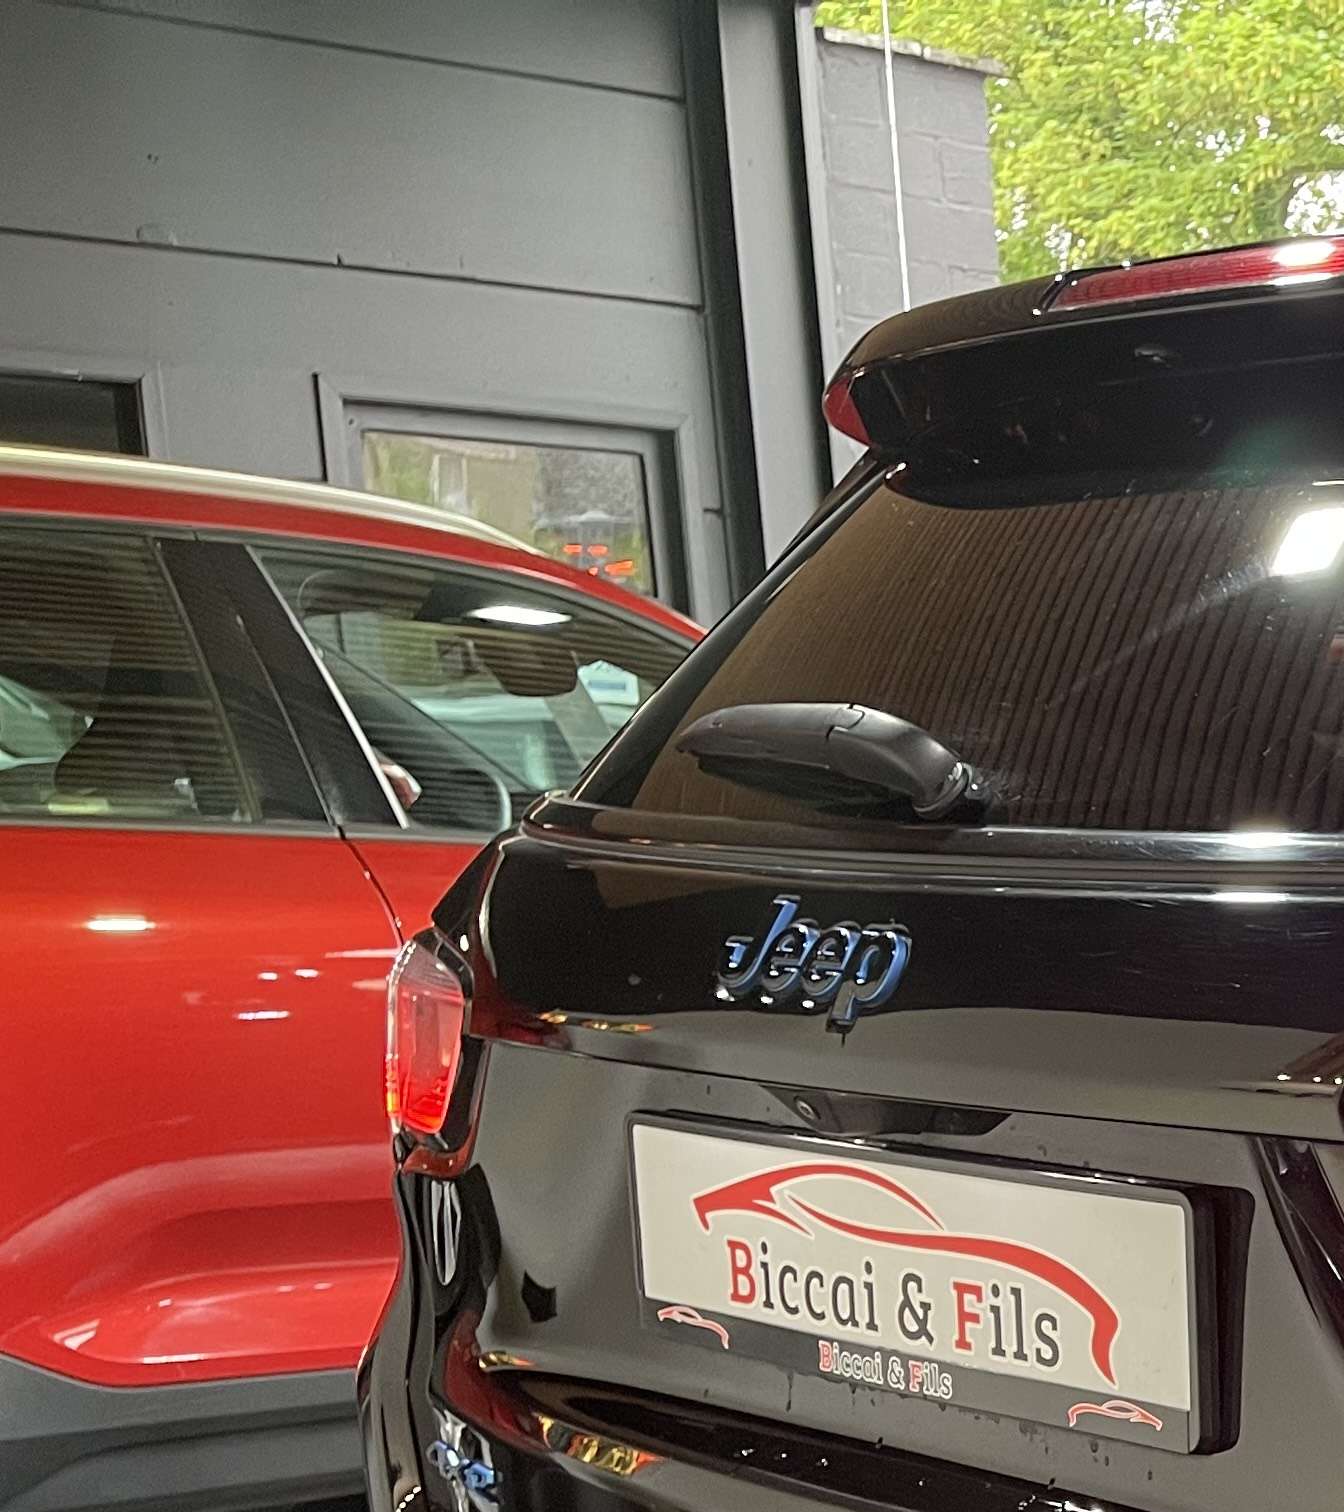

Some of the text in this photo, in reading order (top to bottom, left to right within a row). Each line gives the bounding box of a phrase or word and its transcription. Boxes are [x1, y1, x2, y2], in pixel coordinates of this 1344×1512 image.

[714, 894, 912, 1034] Jeep
[726, 1239, 1060, 1367] Biccai & Fils
[818, 1340, 953, 1399] Biccai & Fils
